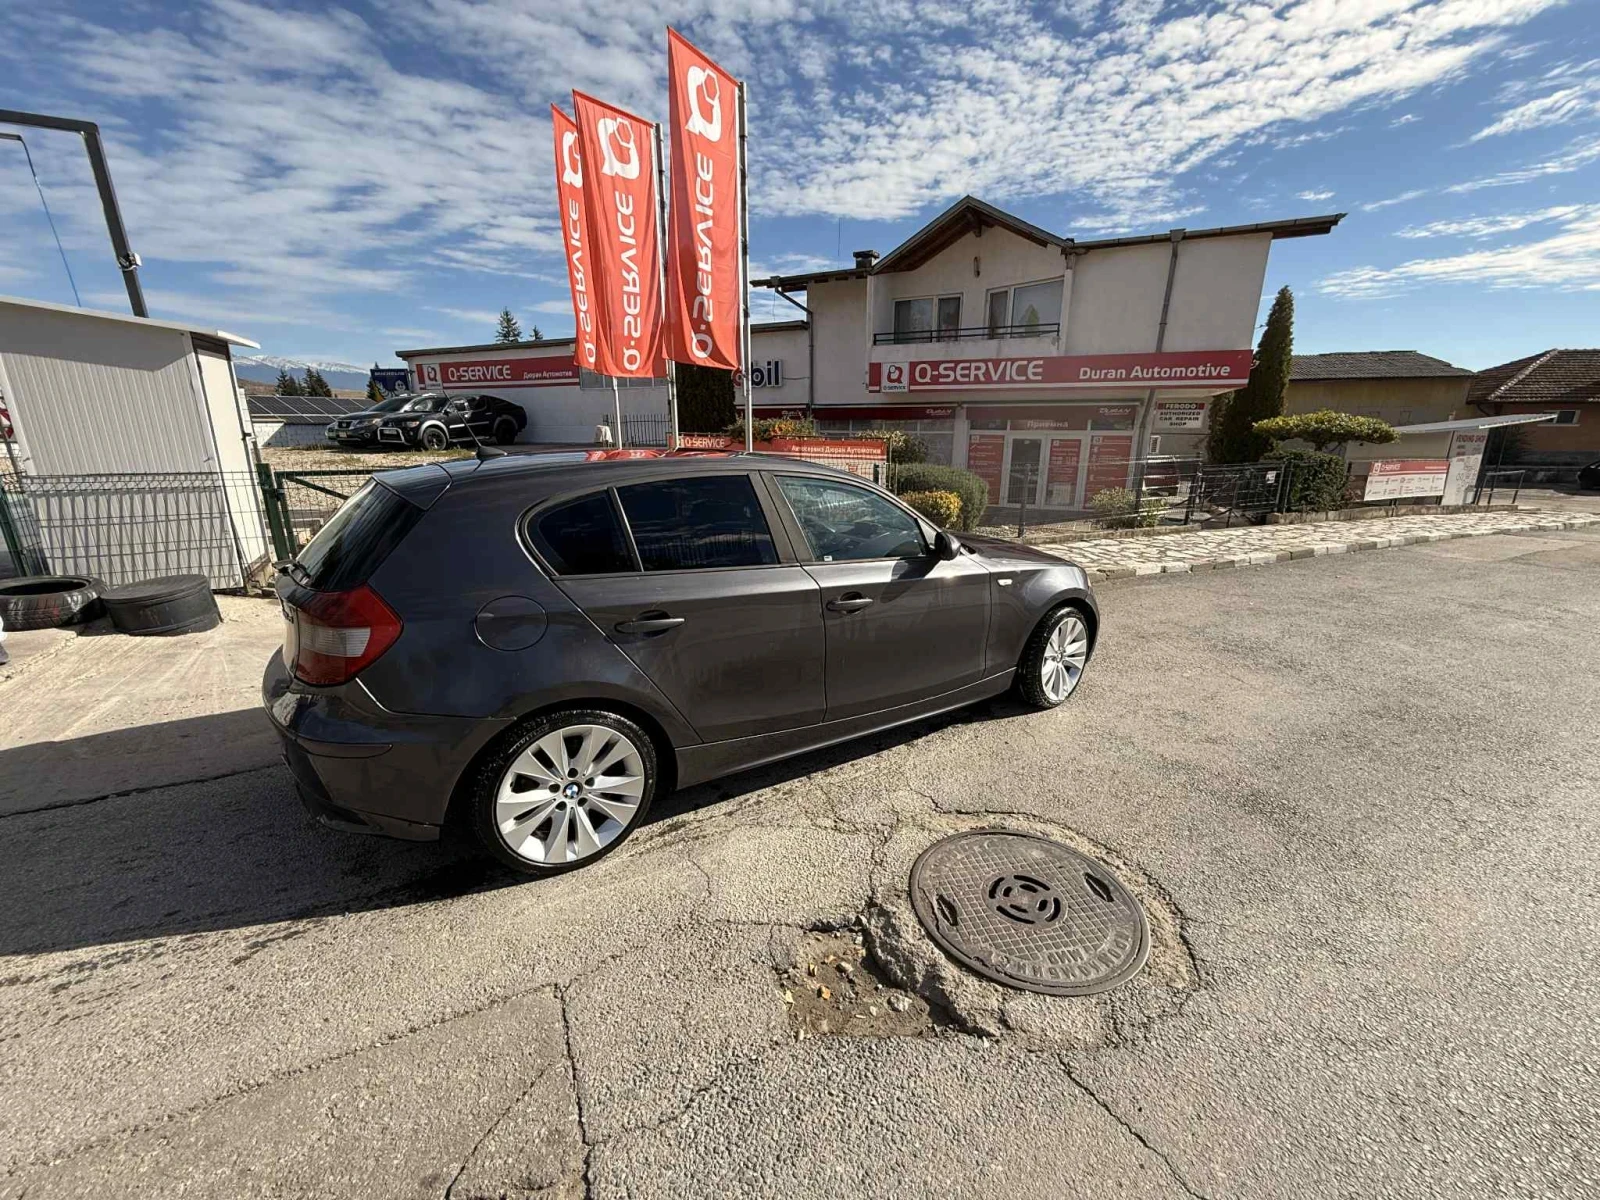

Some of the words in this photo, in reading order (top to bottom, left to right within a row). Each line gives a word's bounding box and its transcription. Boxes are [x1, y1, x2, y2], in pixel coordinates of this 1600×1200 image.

[448, 364, 512, 381] Q-SERVICE
[914, 359, 1044, 384] Q-SERVICE
[1078, 366, 1127, 380] Duran
[1129, 363, 1232, 379] Automotive
